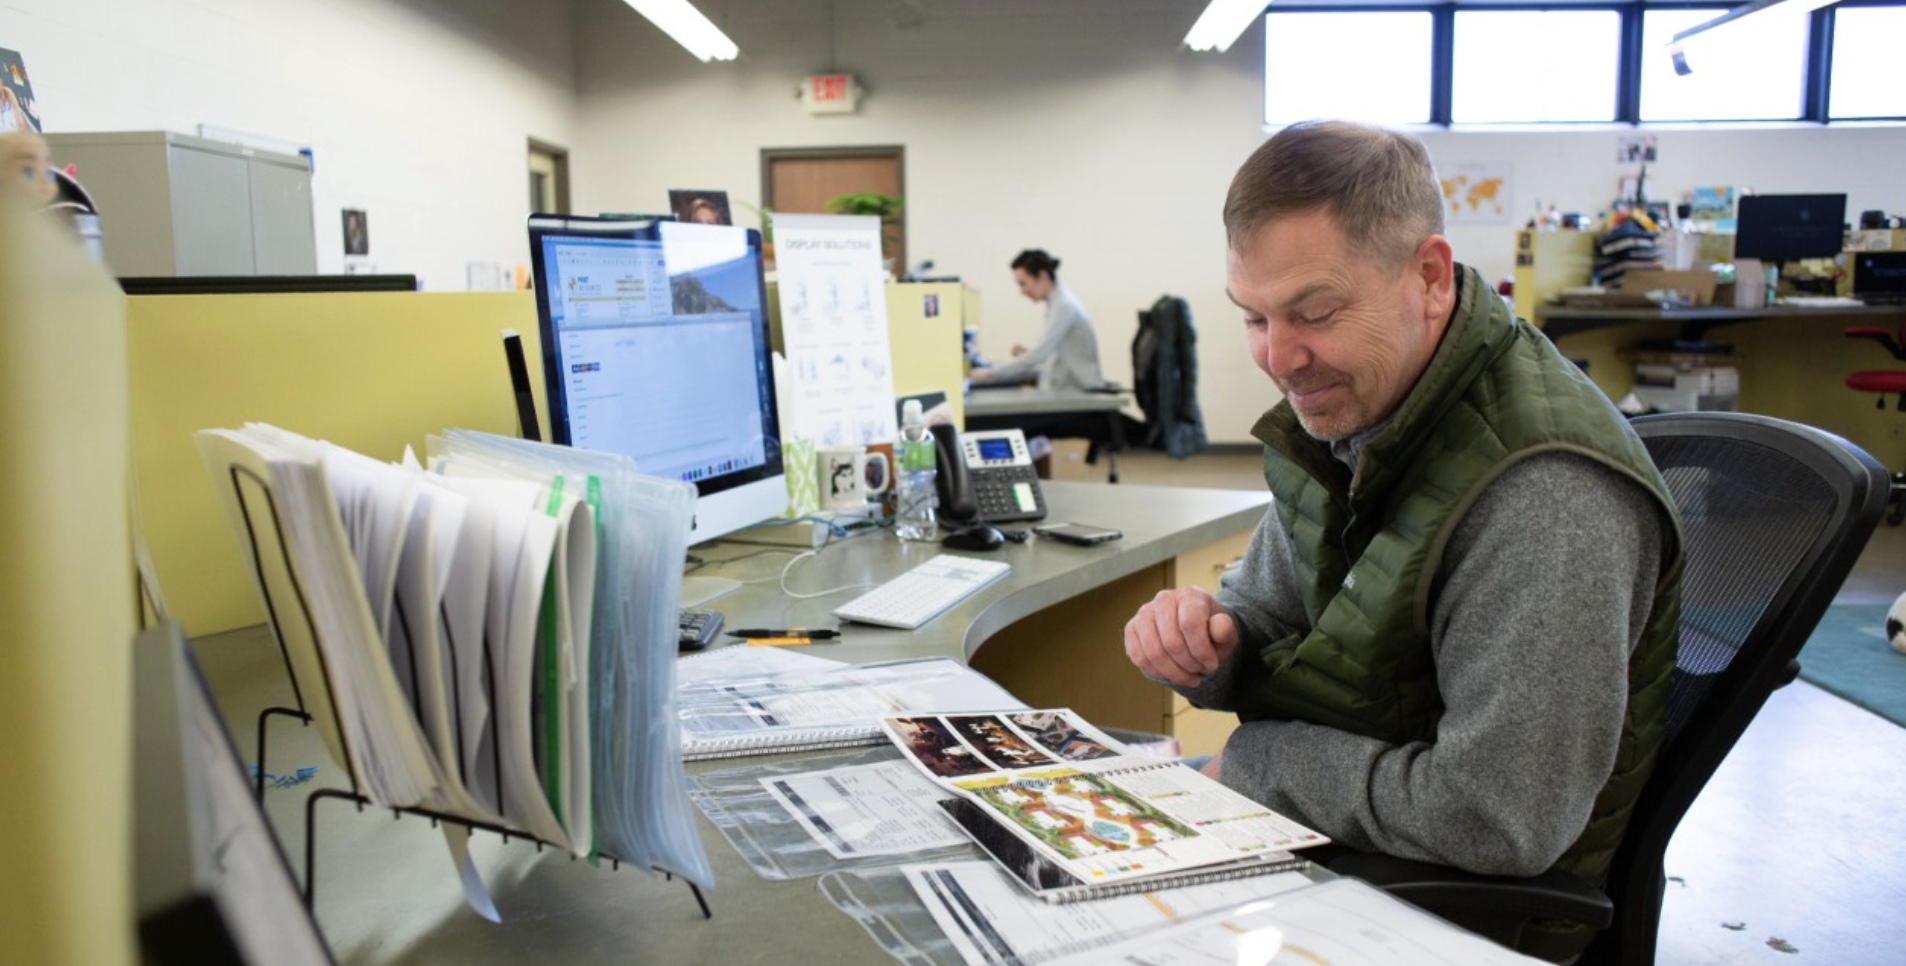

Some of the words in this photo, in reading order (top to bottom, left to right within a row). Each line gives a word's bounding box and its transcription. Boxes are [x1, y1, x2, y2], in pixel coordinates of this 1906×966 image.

[812, 76, 847, 102] EXIT
[786, 239, 822, 249] DISPLAY
[824, 239, 872, 249] SOLUTIONS
